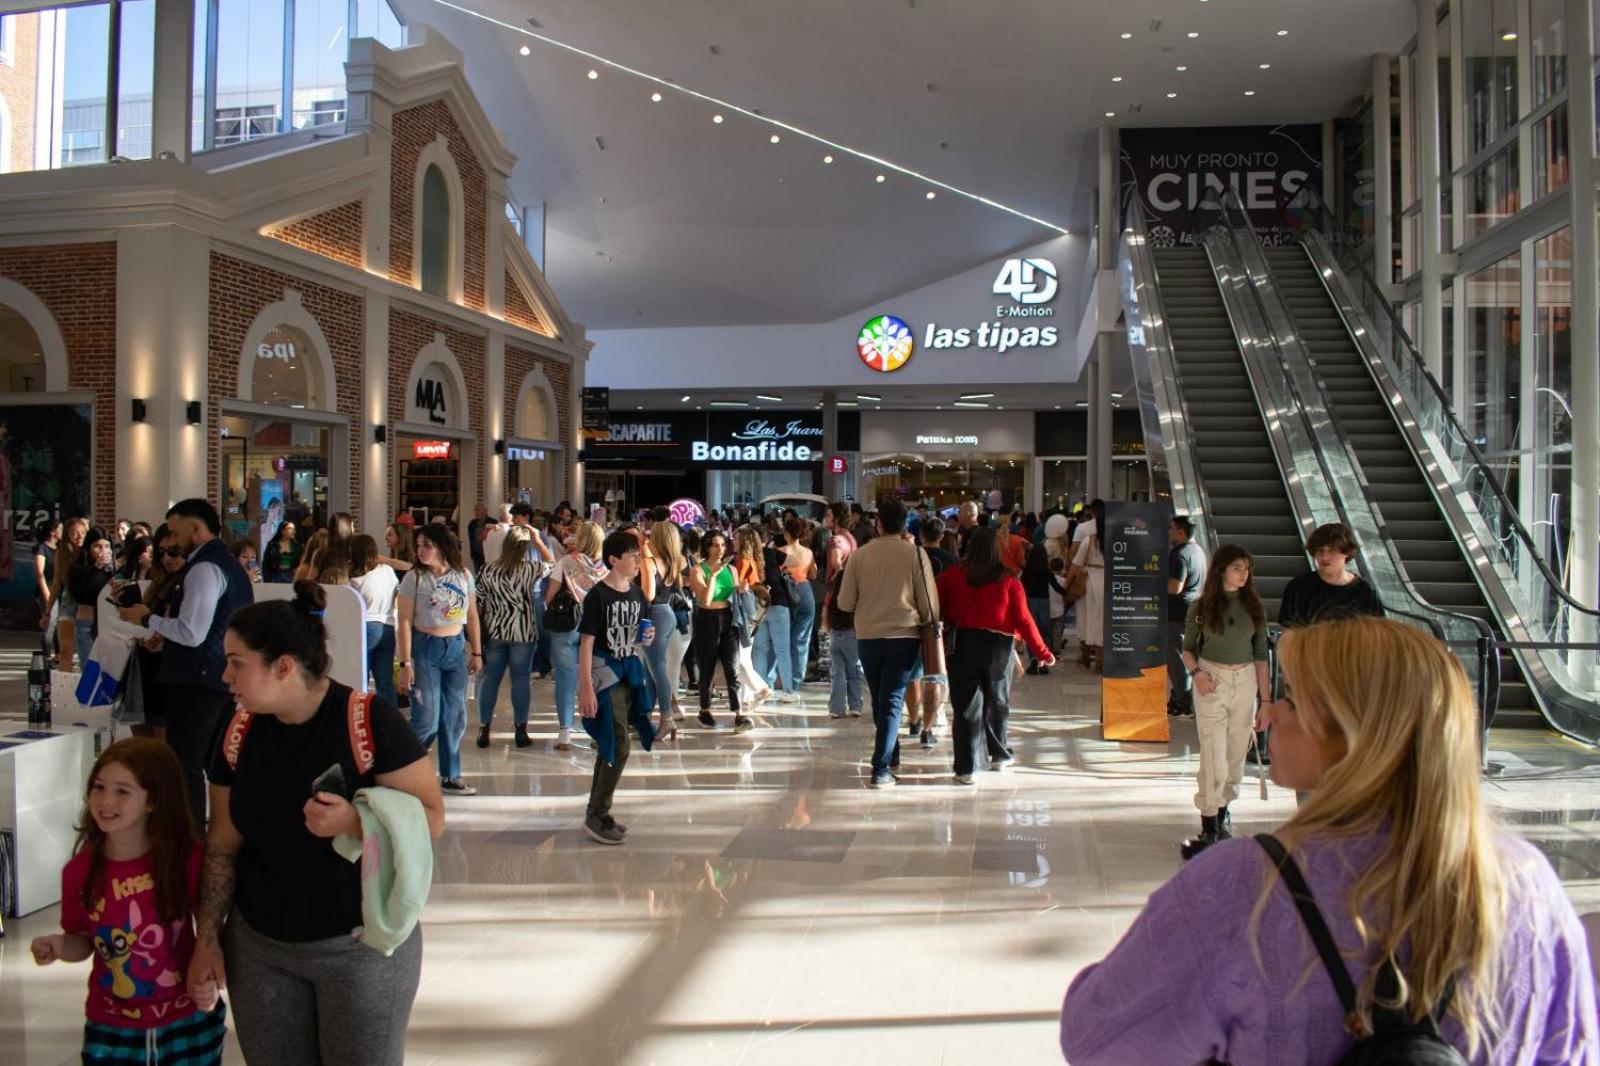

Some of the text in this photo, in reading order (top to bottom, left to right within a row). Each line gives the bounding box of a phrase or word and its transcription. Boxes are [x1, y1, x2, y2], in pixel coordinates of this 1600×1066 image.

[1150, 152, 1279, 169] MUY PRONTO
[1147, 170, 1319, 211] CINES
[992, 257, 1058, 304] 4D
[996, 305, 1053, 317] E-Motion
[924, 321, 1058, 353] las tipas
[692, 441, 811, 461] Bonafide
[1112, 582, 1132, 594] PB
[1112, 633, 1130, 645] SS
[353, 702, 367, 741] SELF
[226, 724, 245, 764] LOVE
